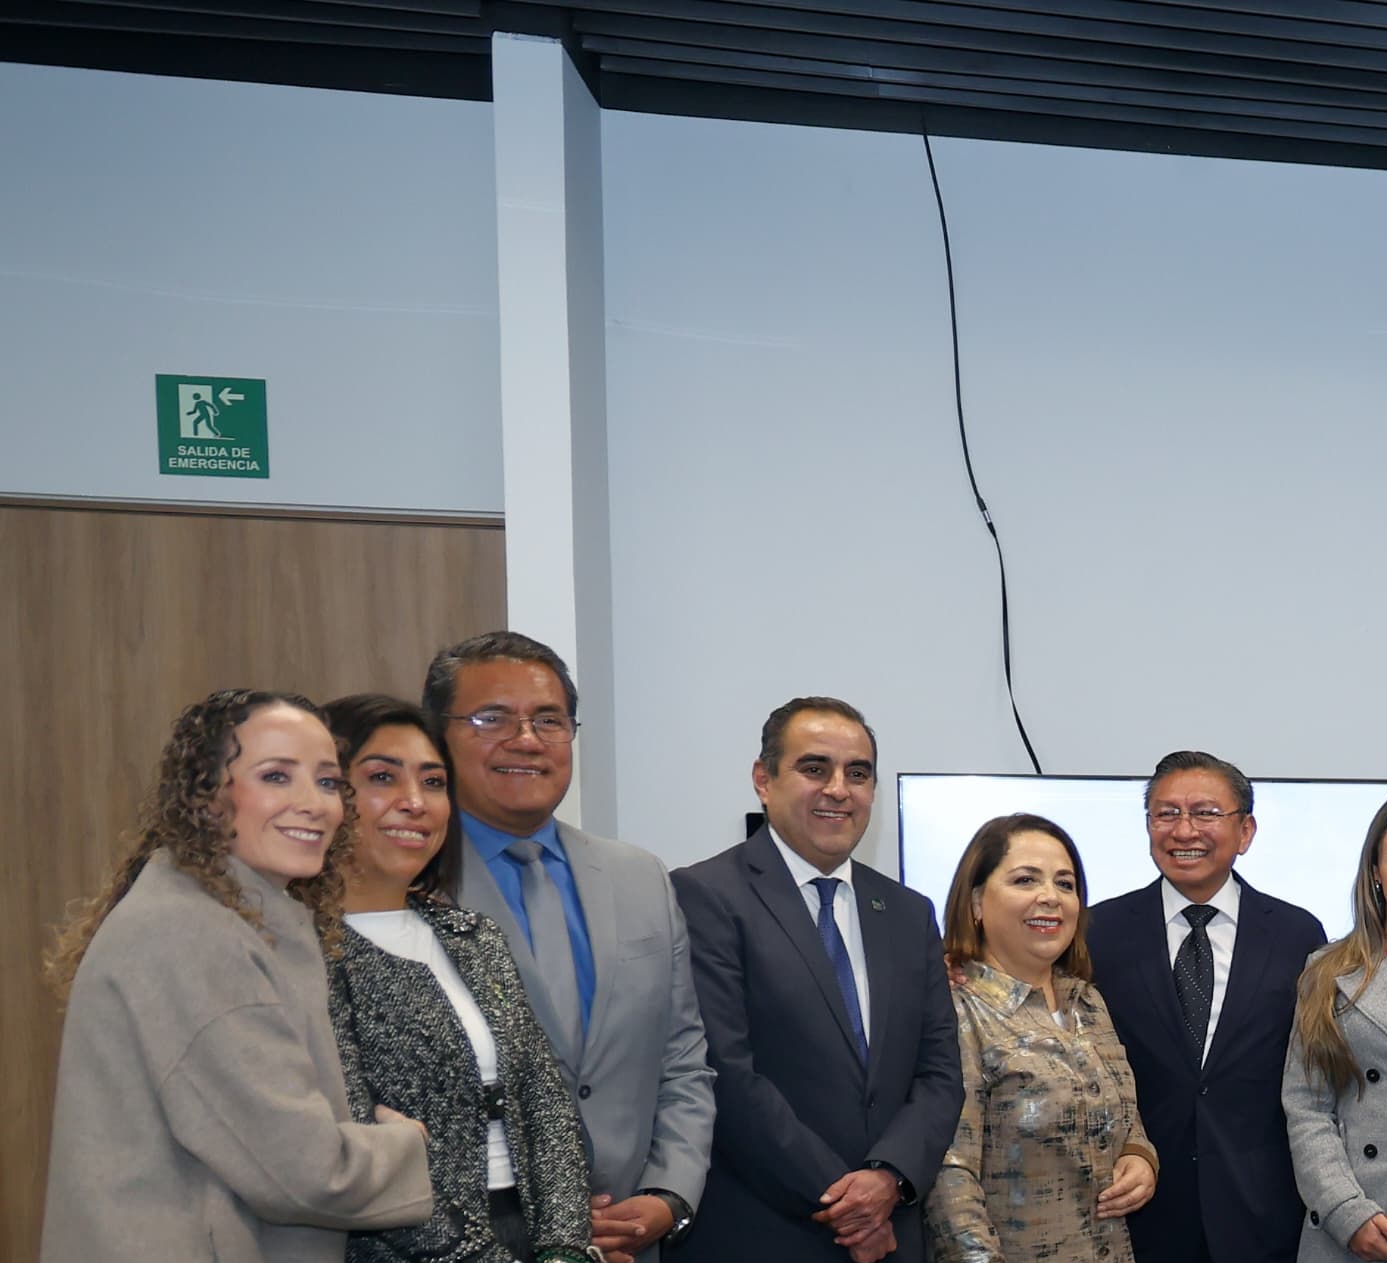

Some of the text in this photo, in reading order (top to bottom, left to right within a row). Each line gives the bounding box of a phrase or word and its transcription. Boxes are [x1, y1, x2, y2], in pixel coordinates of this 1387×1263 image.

[177, 445, 251, 458] SALIDA DE
[168, 457, 260, 471] EMERGENCIA
